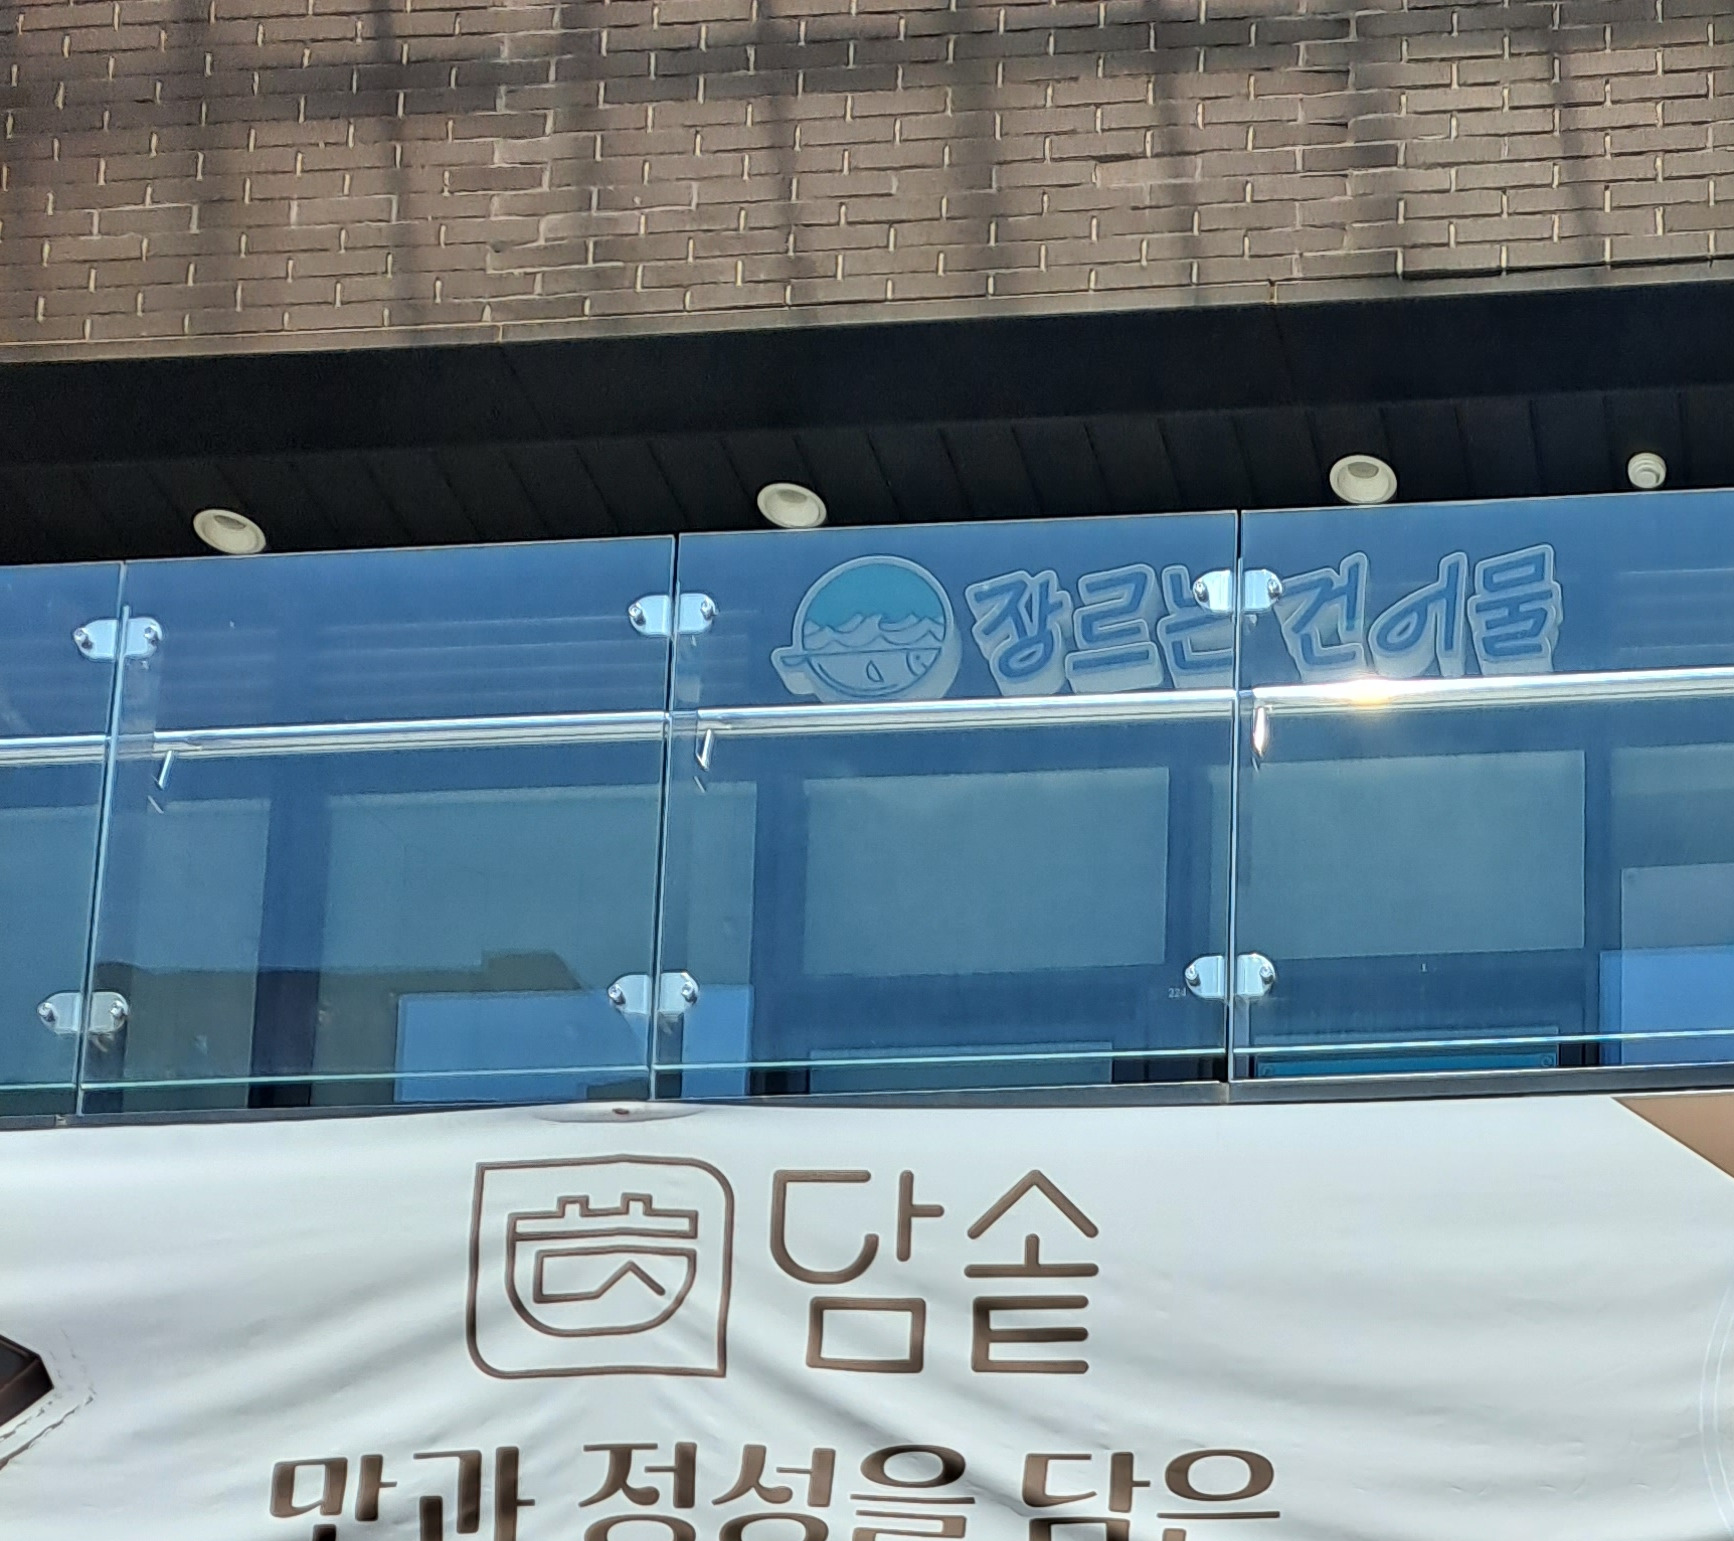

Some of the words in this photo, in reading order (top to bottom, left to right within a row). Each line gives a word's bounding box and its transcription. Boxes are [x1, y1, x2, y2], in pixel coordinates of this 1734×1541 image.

[965, 563, 1237, 695] 장르는
[1274, 545, 1563, 685] 건어물
[770, 1168, 1099, 1375] 담솥
